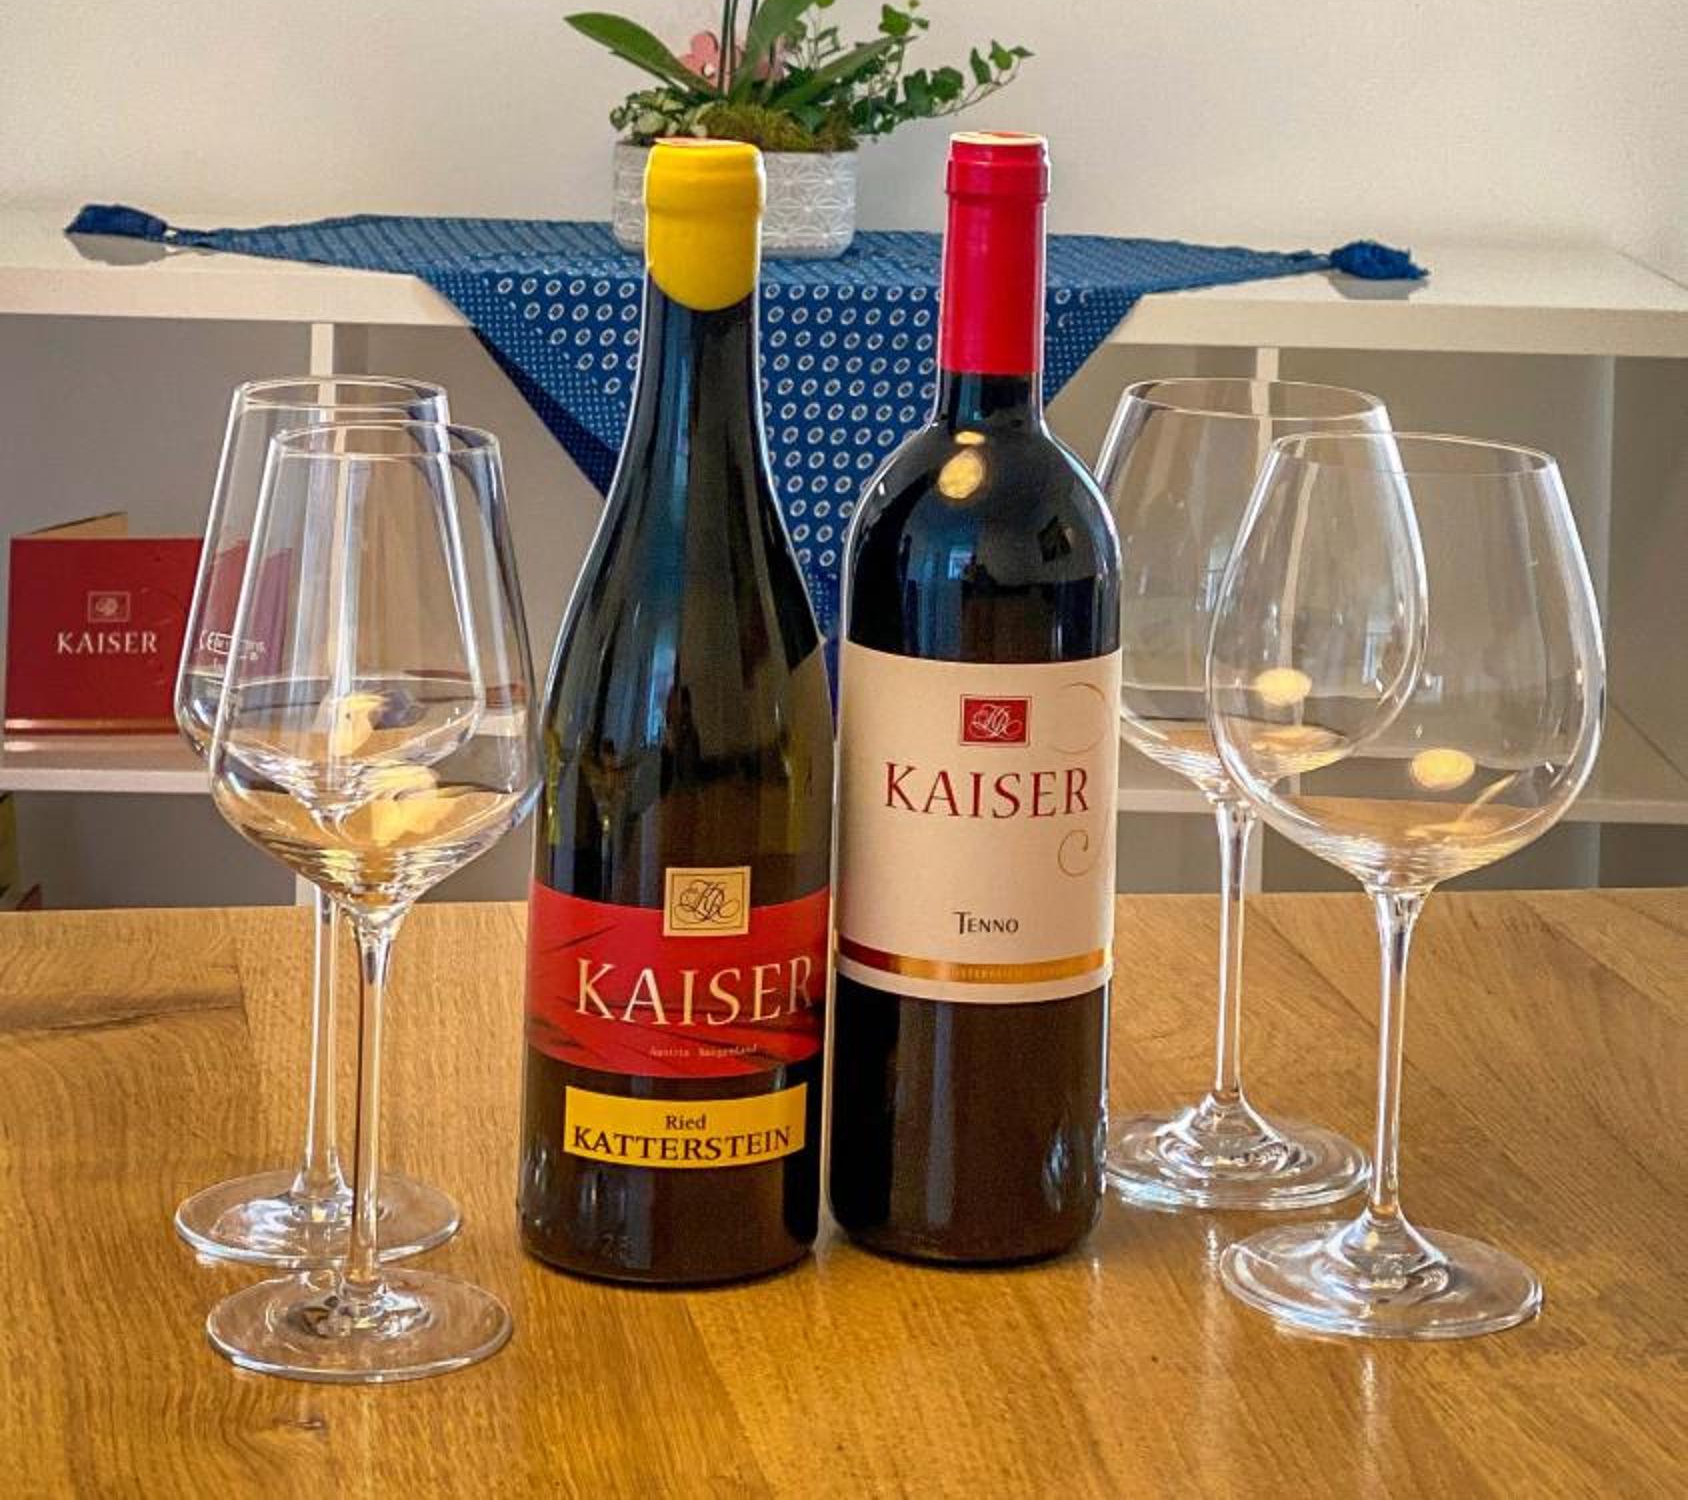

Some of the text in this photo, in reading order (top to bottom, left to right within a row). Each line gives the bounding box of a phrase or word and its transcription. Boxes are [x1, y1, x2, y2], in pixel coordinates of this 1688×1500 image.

[57, 631, 158, 655] KAISER
[884, 761, 1090, 820] KAISER
[953, 911, 1019, 935] TENNO
[575, 956, 815, 1028] KAISER
[664, 1113, 707, 1131] Ried
[573, 1124, 793, 1161] KATTERSTEIN
